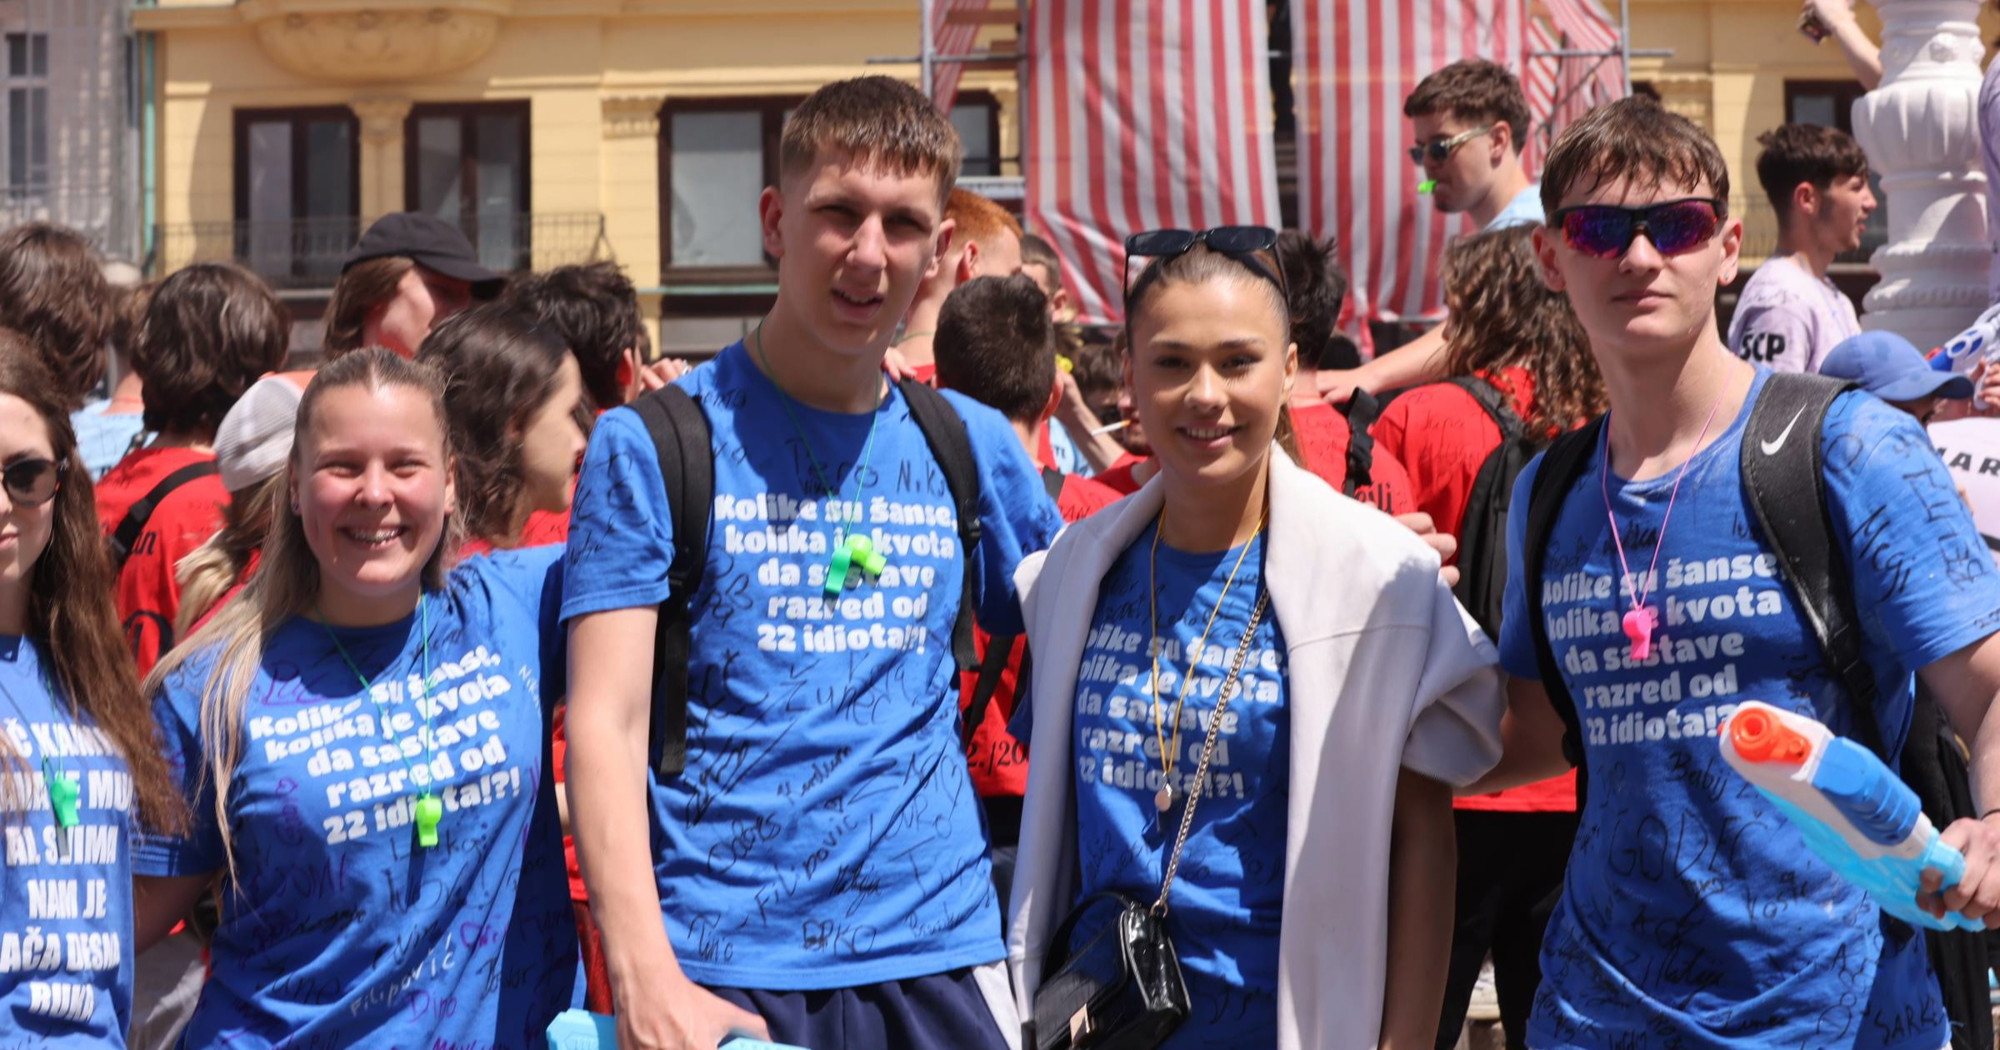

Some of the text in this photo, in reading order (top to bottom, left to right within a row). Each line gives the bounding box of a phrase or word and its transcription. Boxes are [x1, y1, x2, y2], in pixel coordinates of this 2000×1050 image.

[1740, 331, 1785, 362] SCP
[714, 492, 958, 532] Kolike su šanse,
[725, 525, 827, 554] kolika
[871, 527, 955, 560] kvota
[757, 557, 801, 587] da
[1619, 569, 1659, 597] su
[767, 592, 930, 621] razred od
[1547, 607, 1620, 642] kolika
[1666, 585, 1783, 627] kvota
[757, 623, 797, 652] 22
[1145, 636, 1181, 662] su
[1564, 645, 1598, 676] da
[370, 679, 404, 705] su
[1140, 668, 1177, 696] je
[1583, 664, 1739, 710] razred od
[264, 671, 512, 764] kolika je kvota
[1078, 686, 1239, 735] da sastave
[306, 708, 501, 778] da sastave
[1081, 726, 1230, 767] razred od
[1586, 716, 1606, 746] 22
[325, 733, 508, 809] razred od
[322, 766, 522, 846] 22 idita!?!
[6, 825, 41, 867] AL
[27, 879, 107, 920] NAM JE
[29, 981, 95, 1023] RUKA
